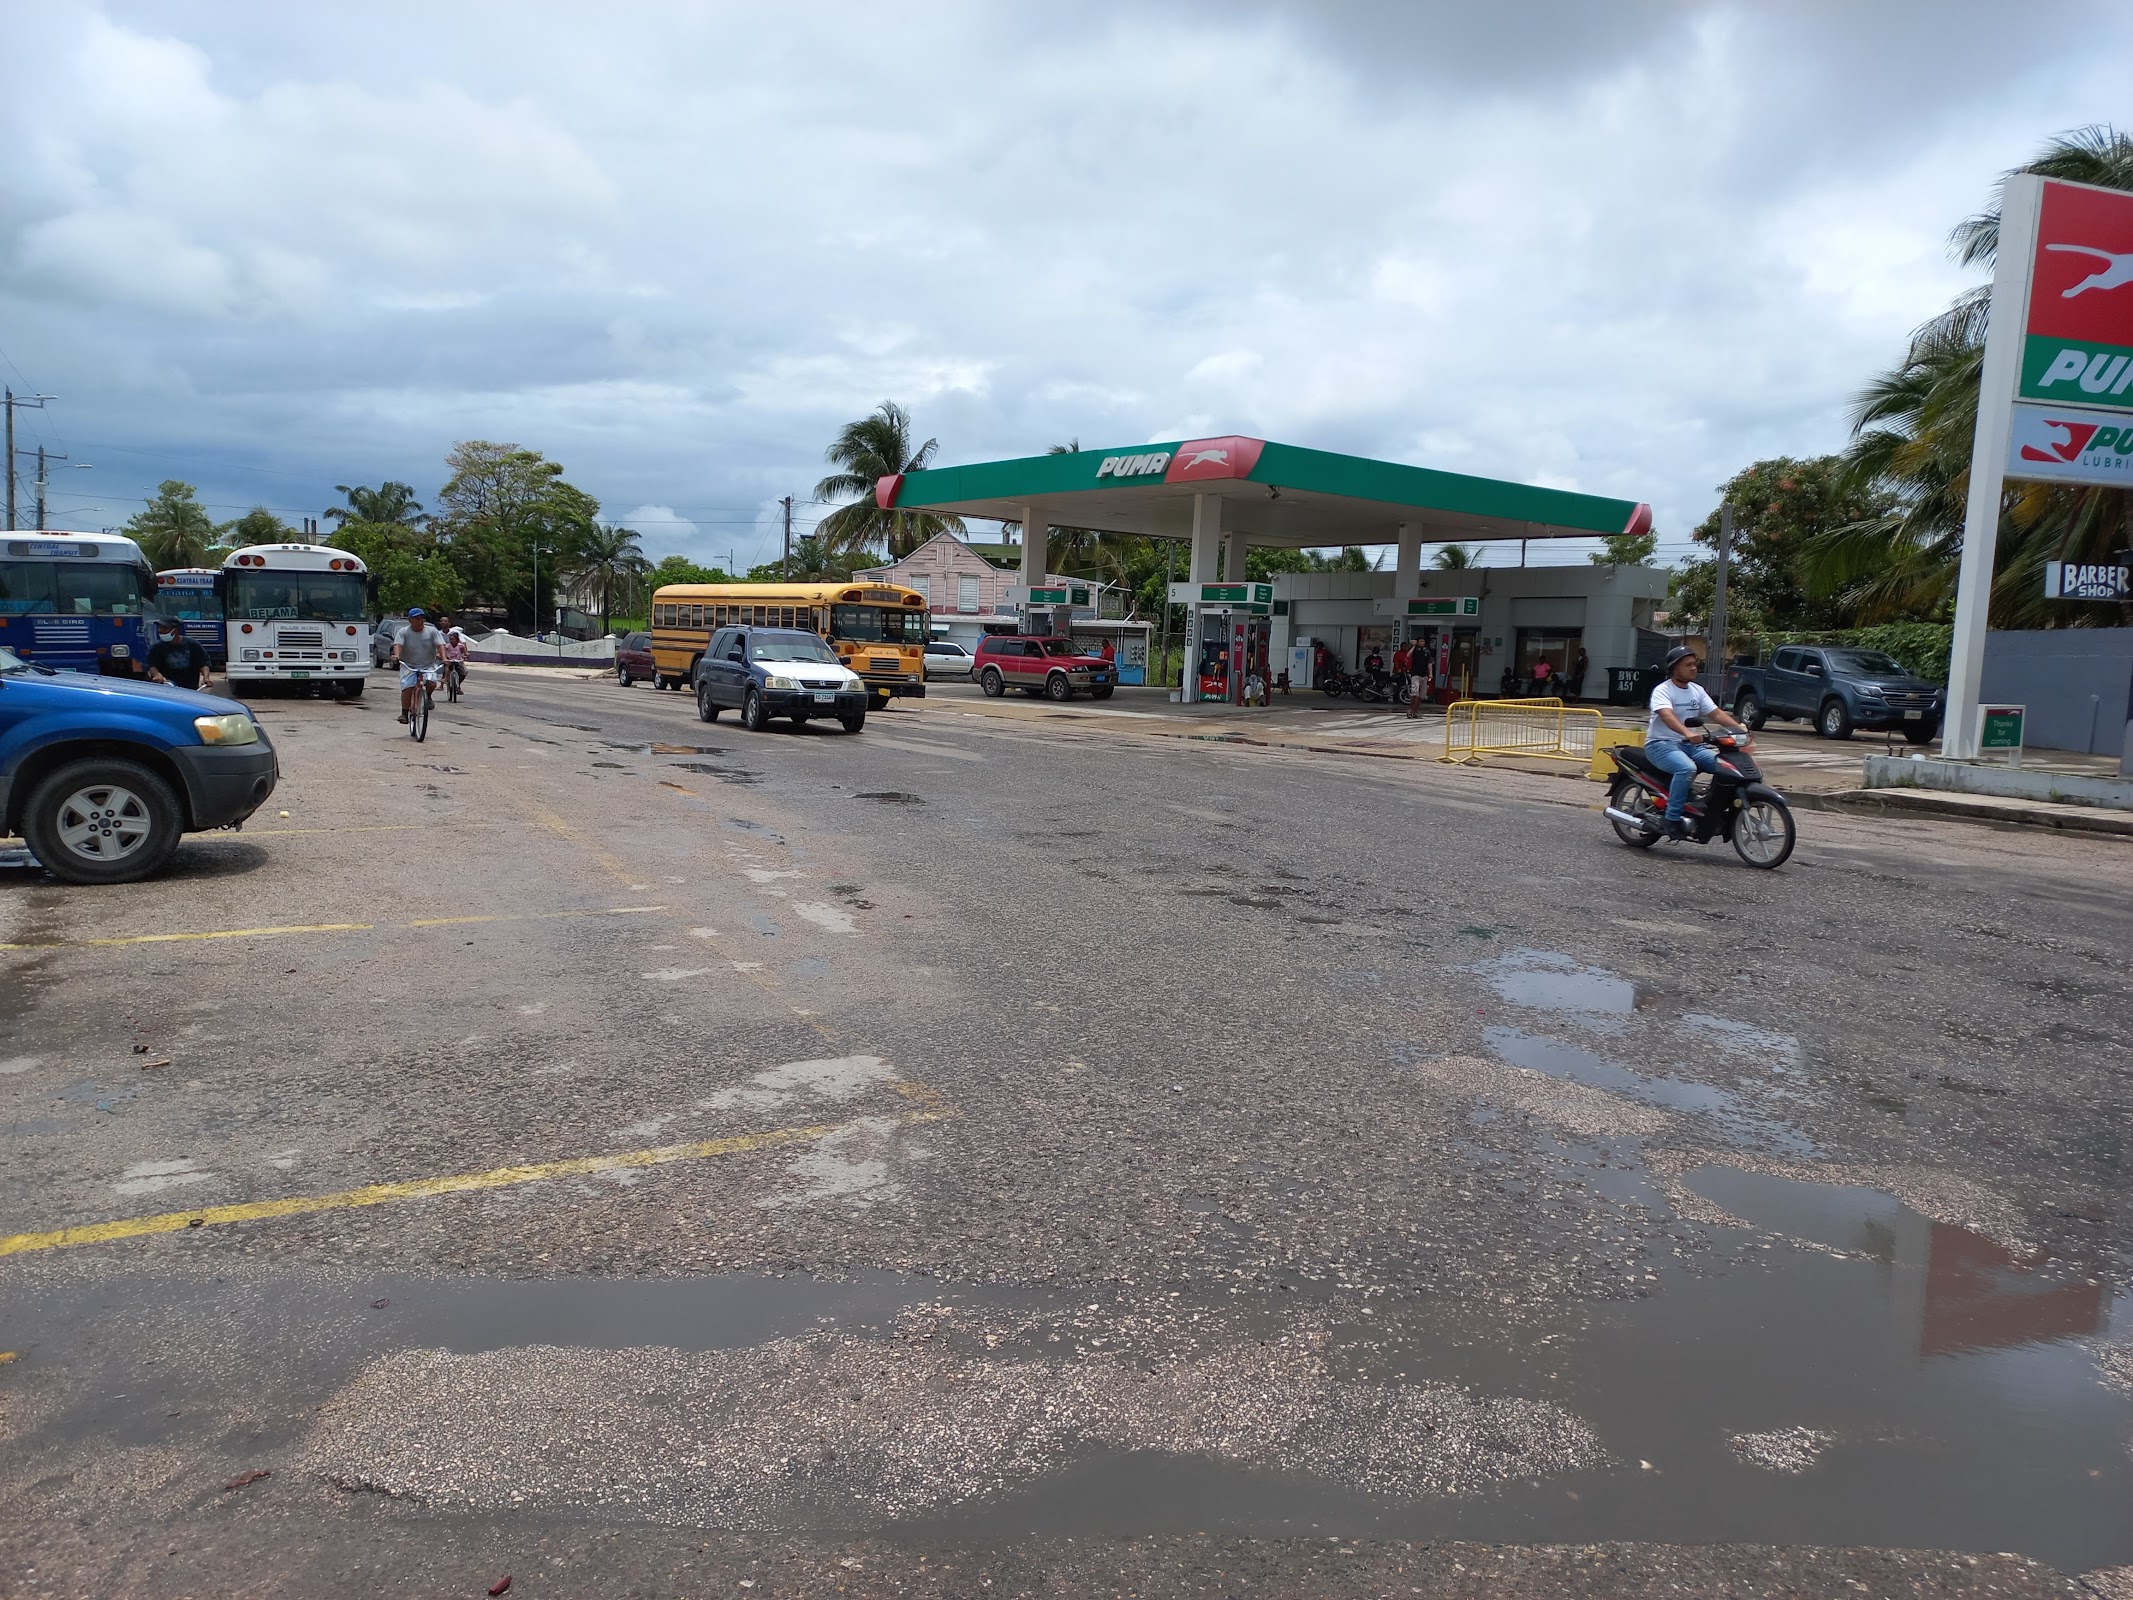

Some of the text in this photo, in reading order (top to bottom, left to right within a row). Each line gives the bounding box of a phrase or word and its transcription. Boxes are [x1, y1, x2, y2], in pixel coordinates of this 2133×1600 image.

[1096, 452, 1171, 478] PUMA
[2083, 456, 2133, 469] LUBRI
[2064, 564, 2130, 593] BARBER
[1005, 590, 1009, 598] 4
[1171, 588, 1176, 597] 5
[2079, 584, 2114, 597] SHOP
[250, 607, 298, 618] BELAMA
[1376, 603, 1381, 611] 7
[1618, 670, 1640, 681] BWC
[1617, 681, 1633, 692] A51
[1990, 738, 2011, 746] coming
